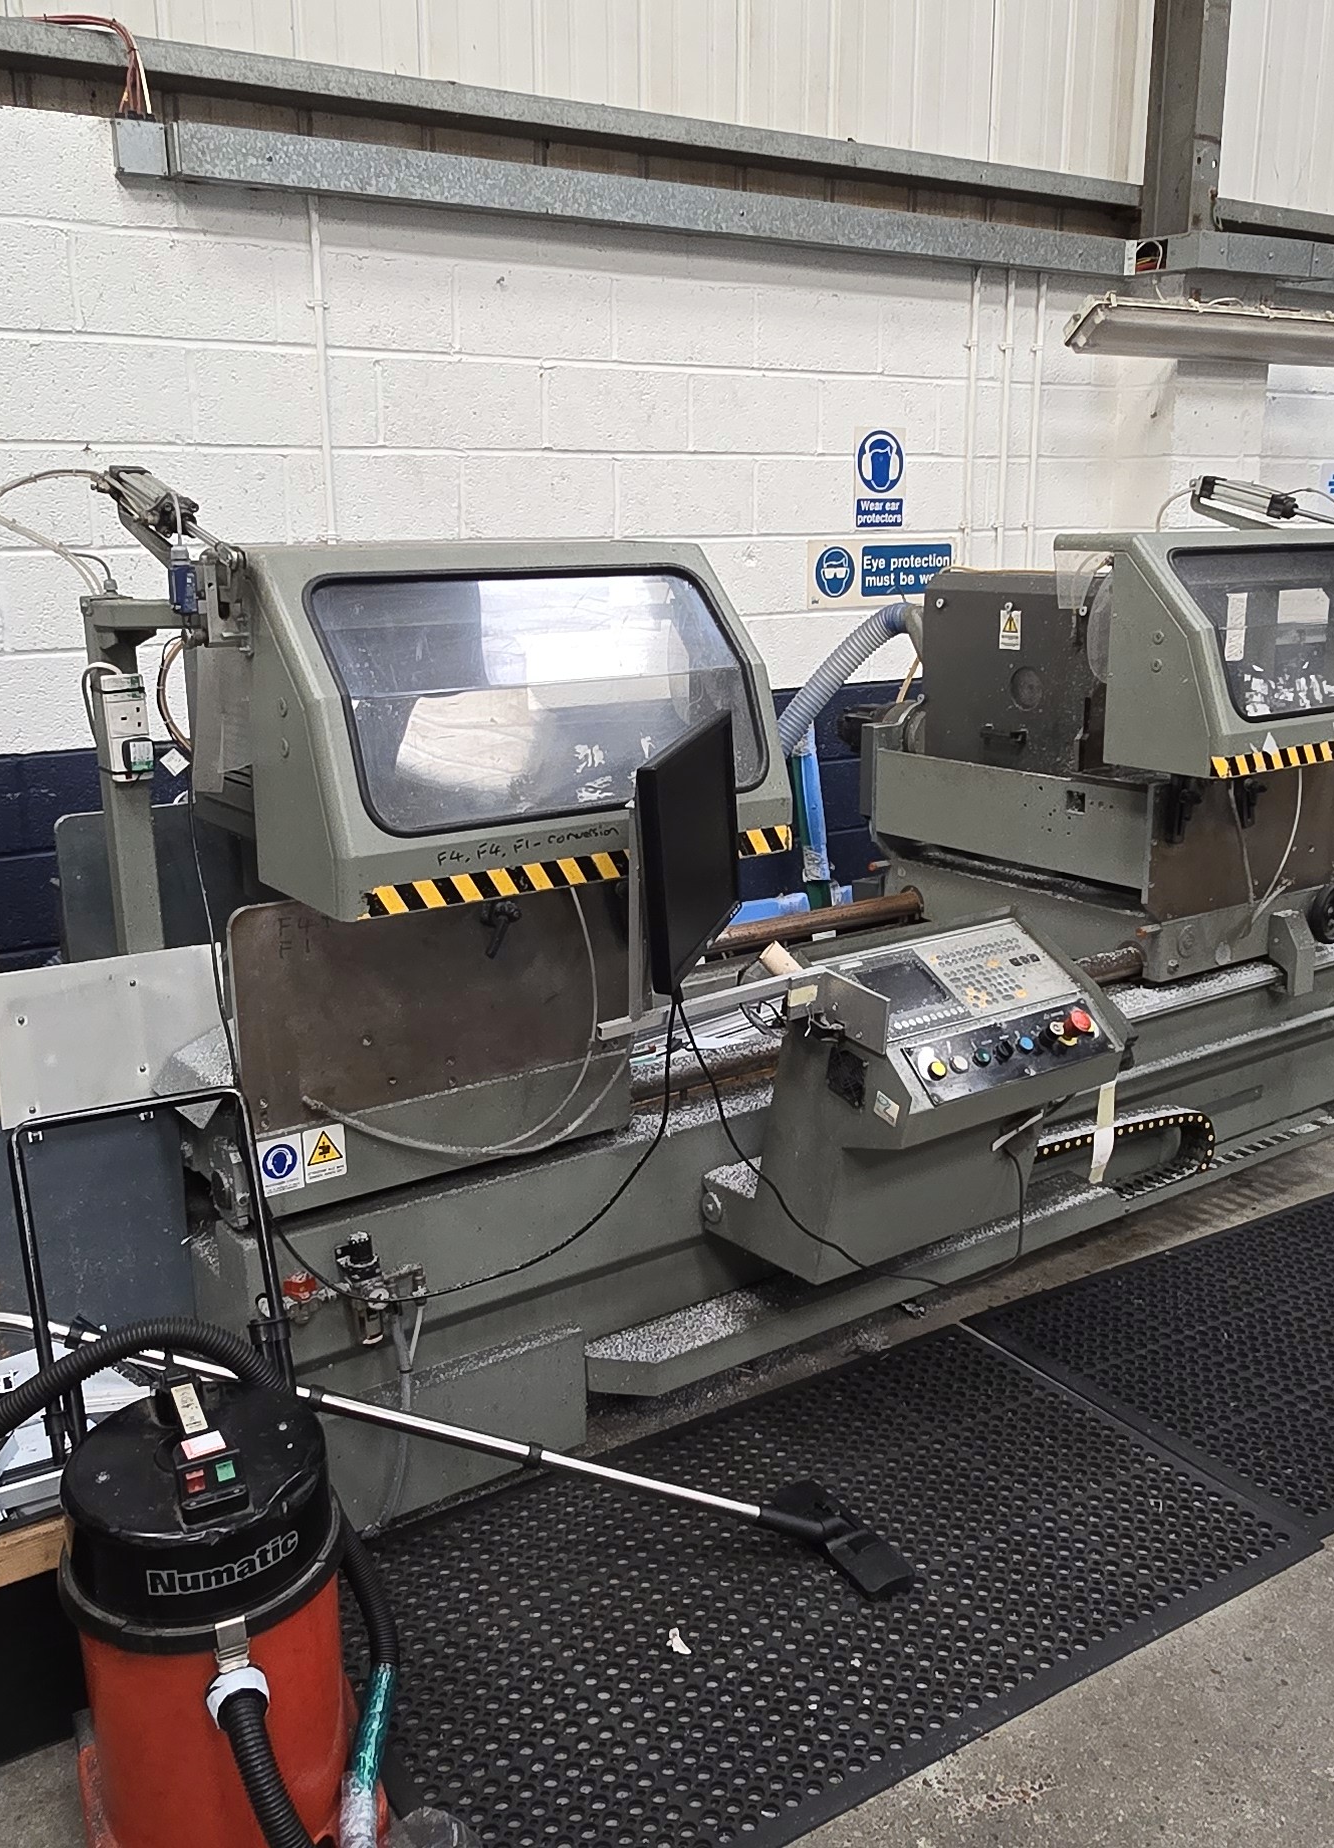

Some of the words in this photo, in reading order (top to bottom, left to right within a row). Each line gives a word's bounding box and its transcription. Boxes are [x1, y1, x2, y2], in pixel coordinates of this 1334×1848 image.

[860, 500, 883, 511] Wear
[885, 501, 900, 511] ear
[857, 513, 902, 525] protectors
[863, 555, 886, 573] Eye
[890, 553, 950, 571] protection
[865, 572, 895, 587] must
[899, 571, 915, 585] be
[146, 1530, 299, 1596] Numatic
